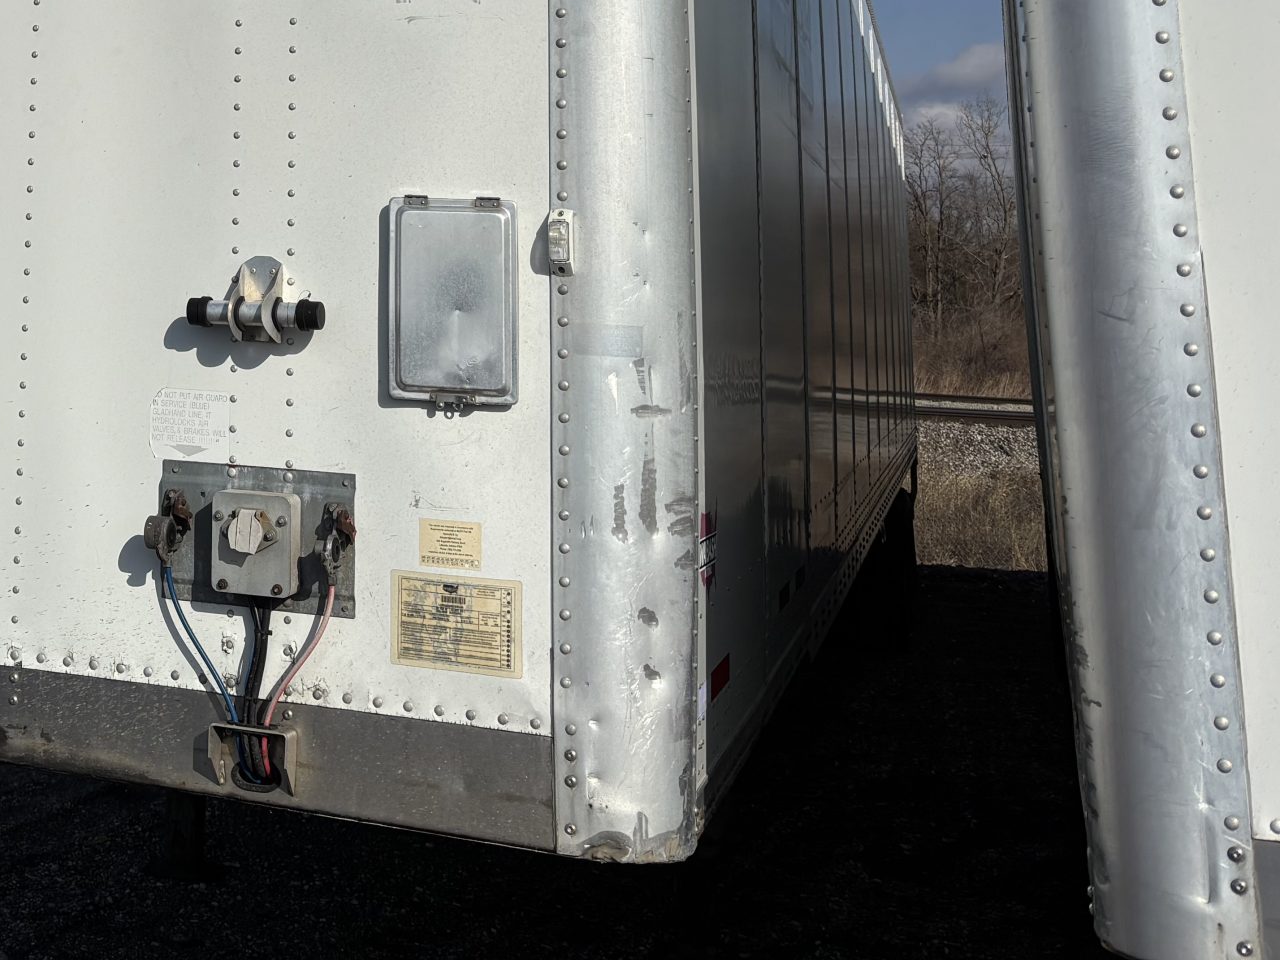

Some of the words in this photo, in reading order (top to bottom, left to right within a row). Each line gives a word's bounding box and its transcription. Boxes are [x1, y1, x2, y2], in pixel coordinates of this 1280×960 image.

[206, 394, 227, 402] GUARD
[161, 400, 187, 408] SERVICE
[184, 428, 209, 436] BRAKES
